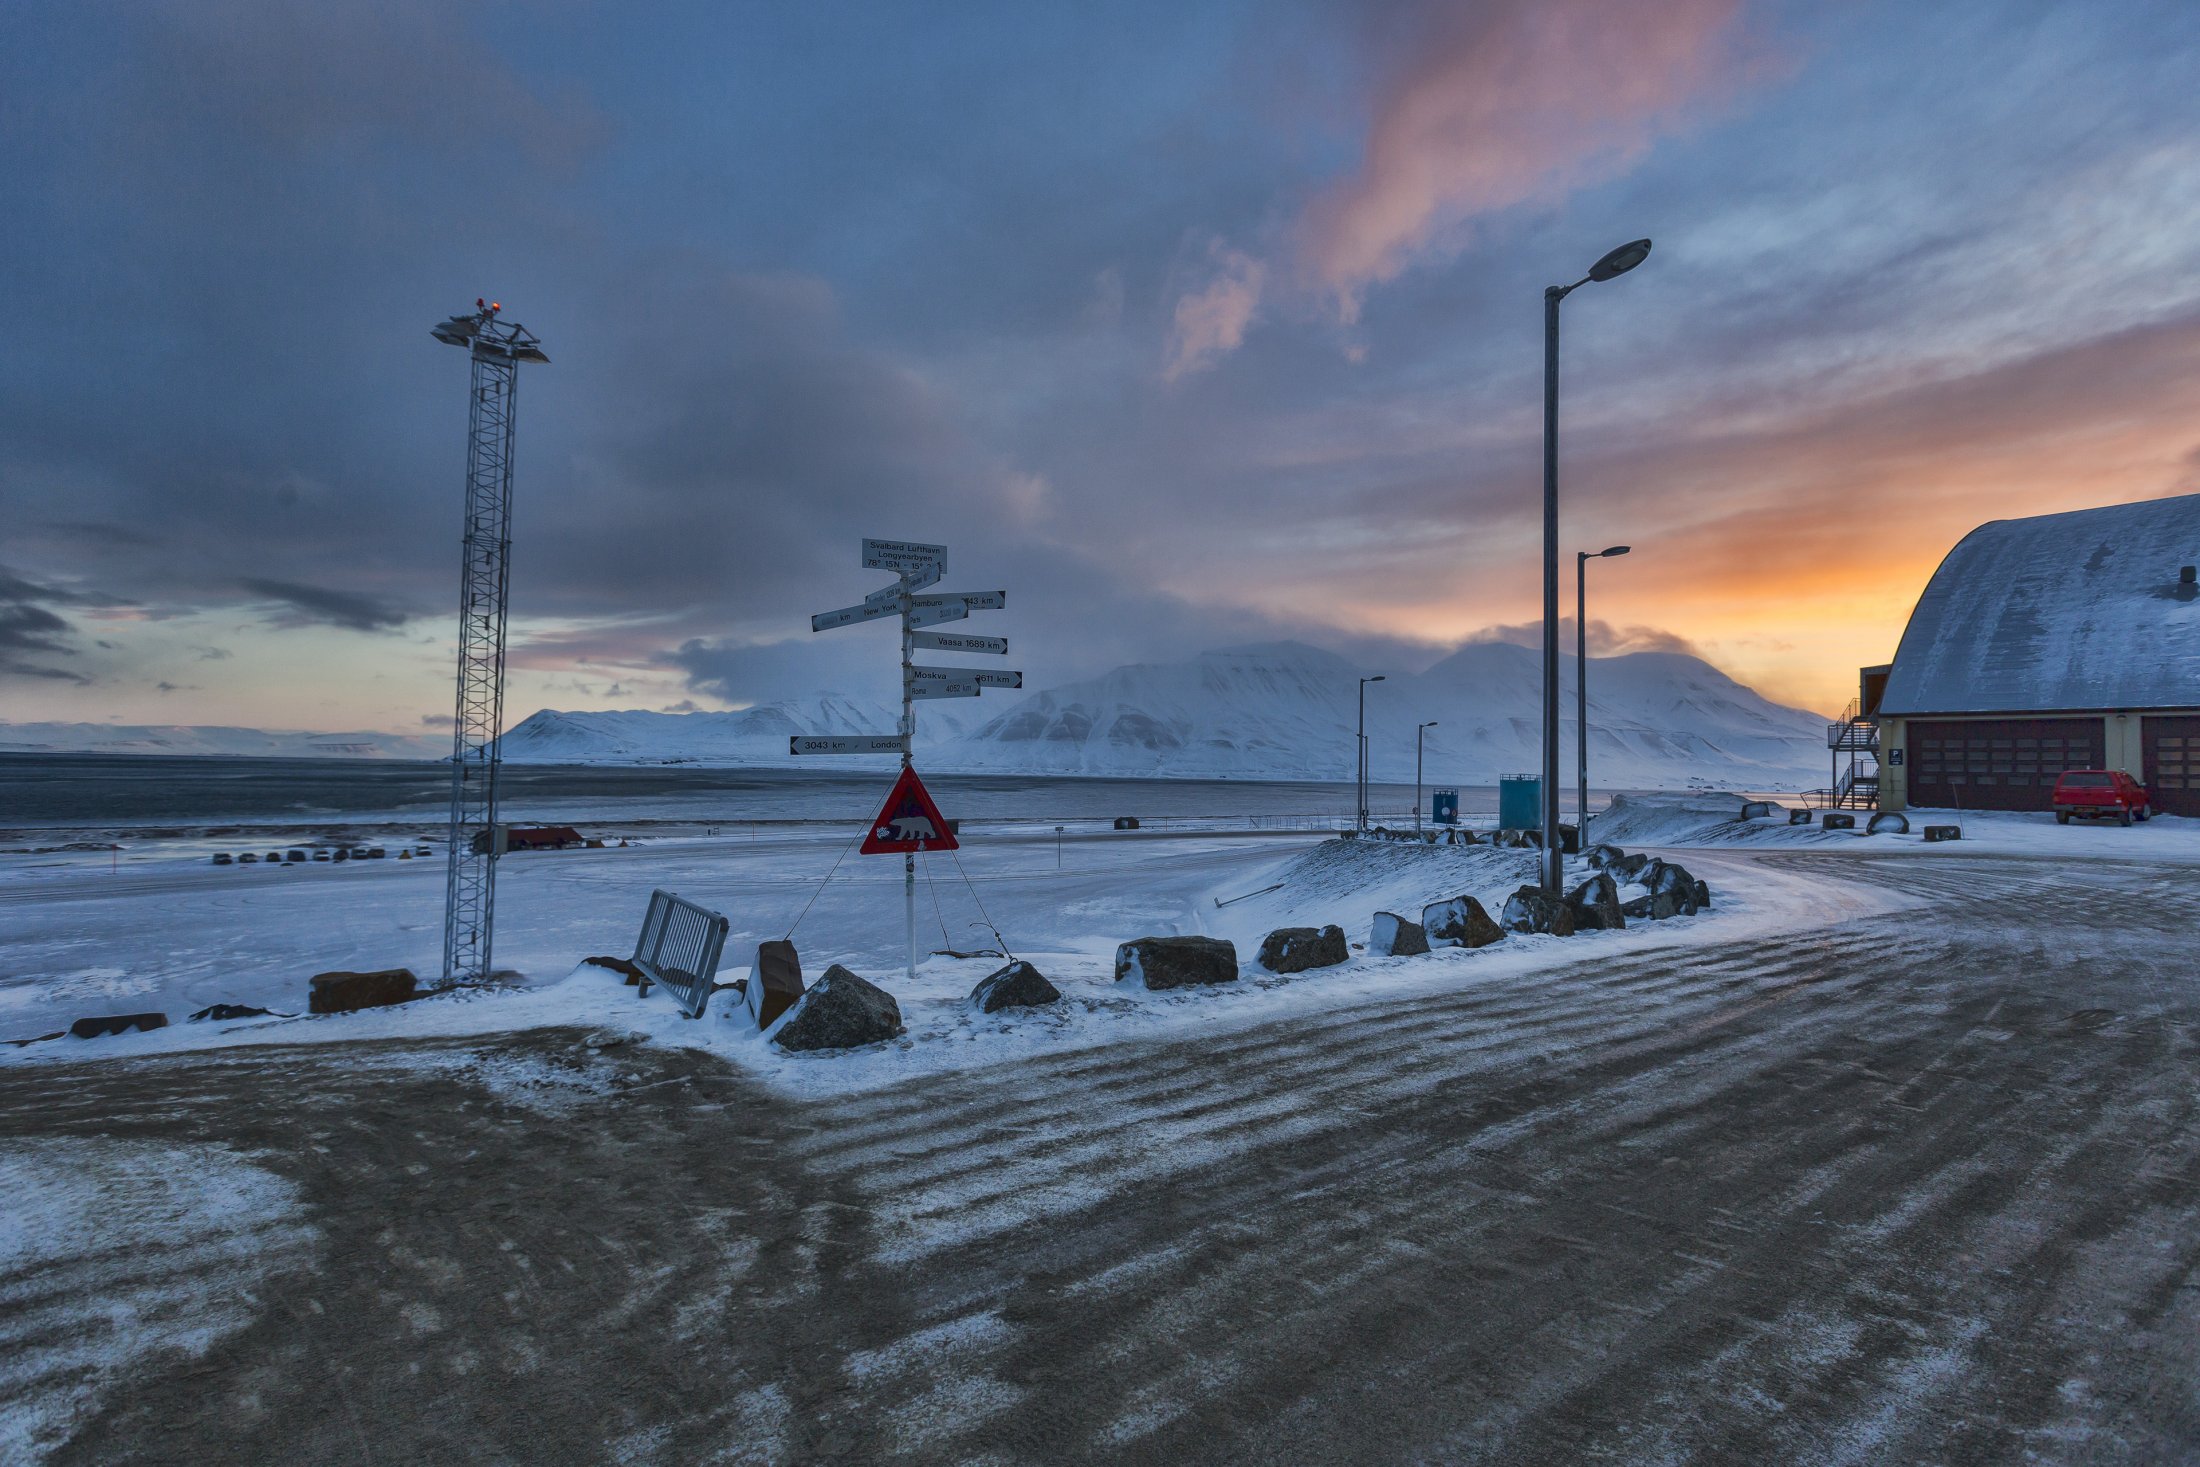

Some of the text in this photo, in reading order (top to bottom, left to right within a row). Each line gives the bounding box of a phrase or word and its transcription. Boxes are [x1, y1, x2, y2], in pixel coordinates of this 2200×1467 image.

[870, 541, 940, 554] Svalbard Lufthavn
[878, 551, 933, 562] Longyearbyen
[867, 559, 881, 567] 78°
[839, 614, 851, 622] km
[863, 607, 879, 617] New
[881, 602, 897, 612] York
[909, 615, 921, 624] Paris
[937, 636, 1000, 650] Vaasa 1689 km
[914, 670, 947, 680] Moskva
[997, 675, 1010, 683] km
[911, 683, 972, 695] Roma 4052 km
[804, 740, 902, 750] 3043 km London
